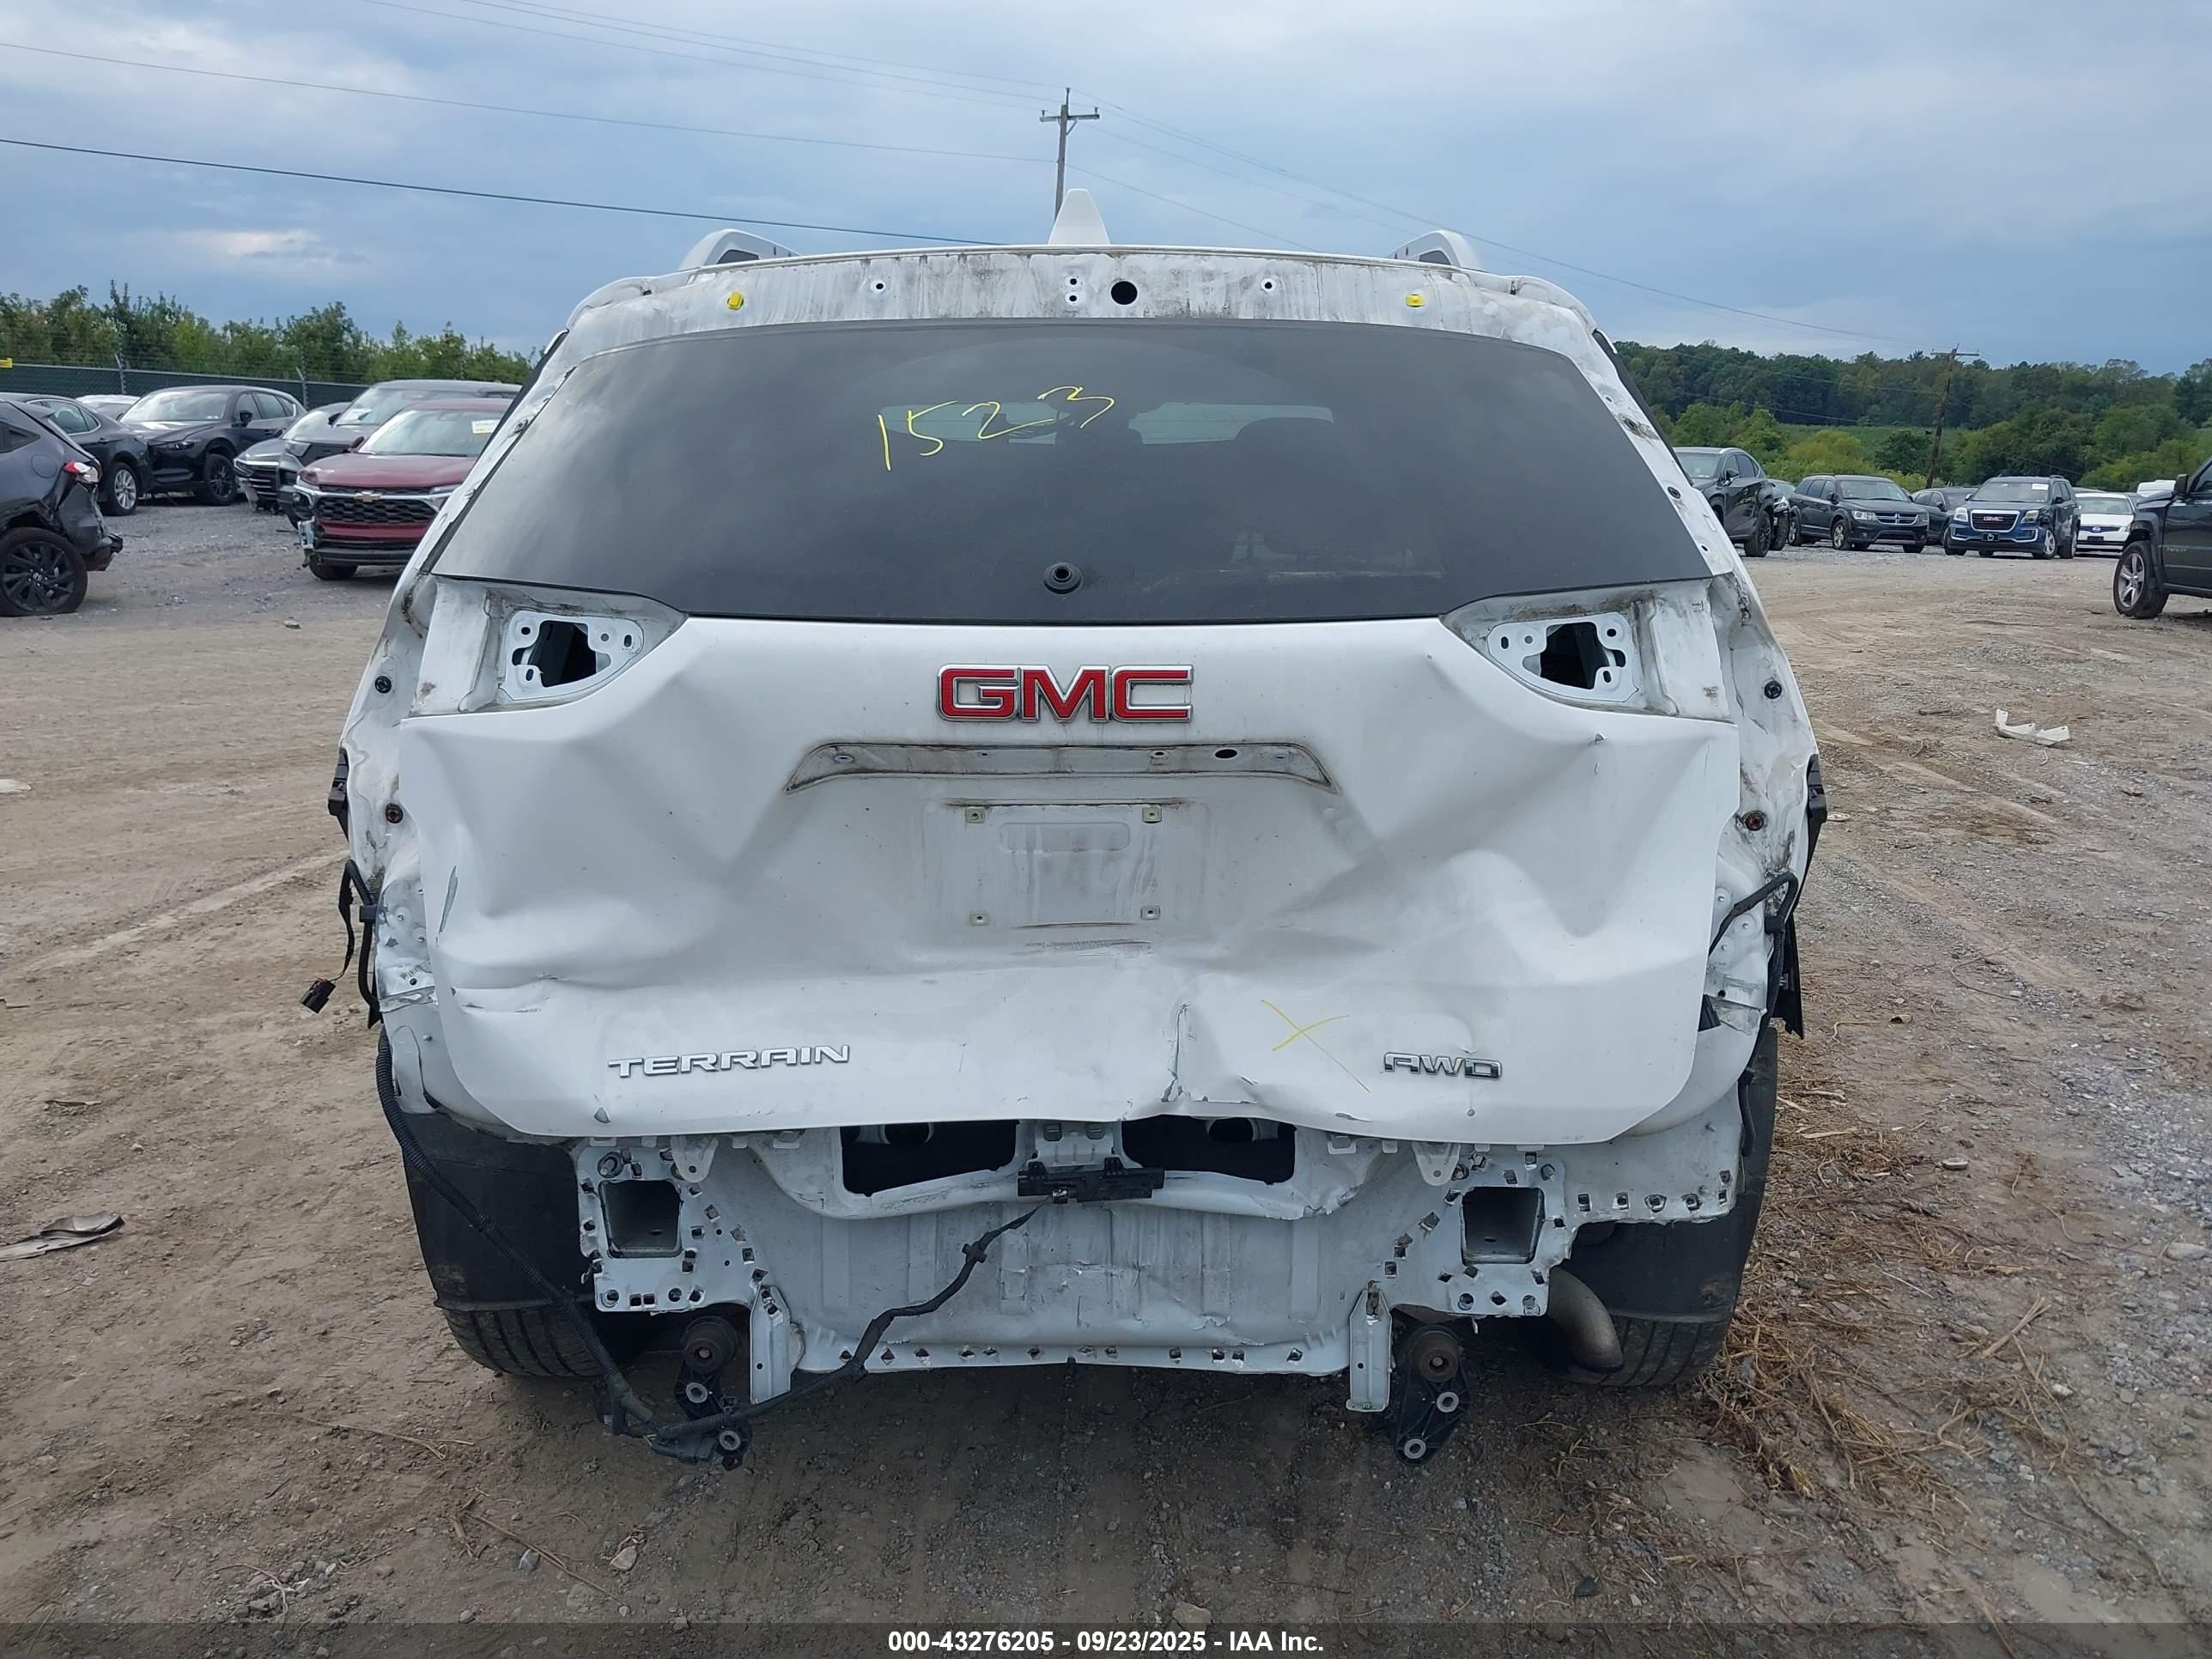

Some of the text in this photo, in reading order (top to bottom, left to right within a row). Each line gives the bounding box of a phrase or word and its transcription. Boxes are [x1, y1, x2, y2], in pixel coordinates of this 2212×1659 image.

[877, 385, 1115, 471] 1523
[937, 663, 1193, 723] GMC
[608, 1044, 850, 1079] TERRAIN
[1383, 1051, 1503, 1081] AWD
